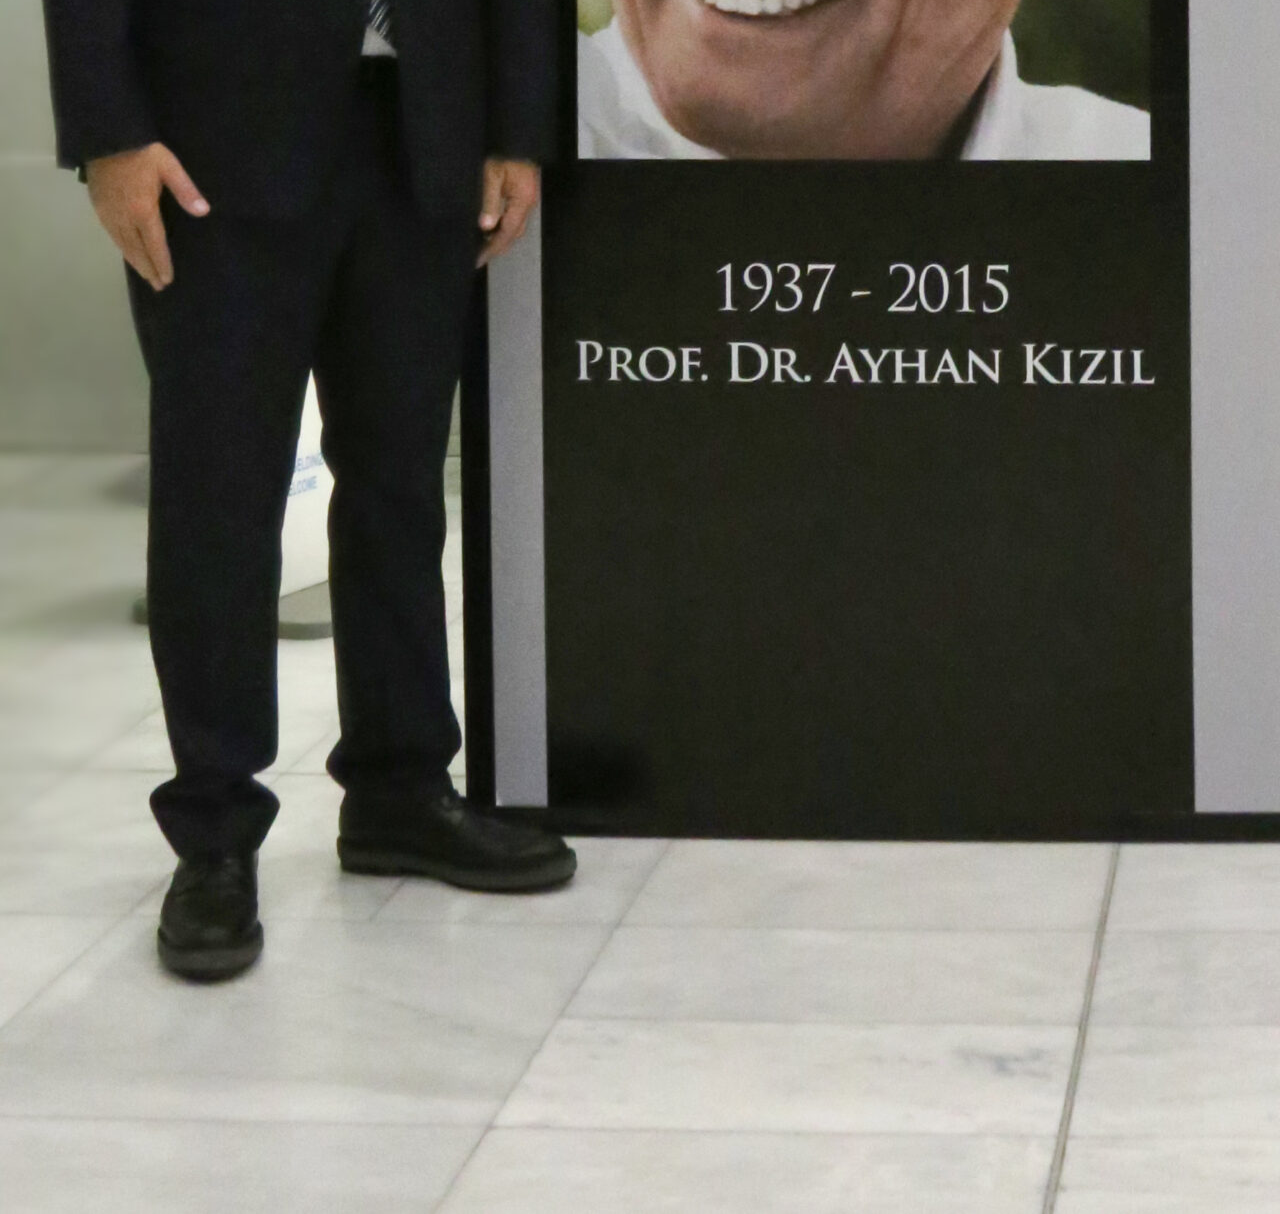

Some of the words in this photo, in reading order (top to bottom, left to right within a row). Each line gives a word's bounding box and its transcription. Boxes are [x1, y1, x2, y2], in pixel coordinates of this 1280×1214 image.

[717, 263, 837, 314] 1937
[888, 264, 1011, 315] 2015
[576, 341, 710, 383] PROF.
[728, 342, 813, 384] DR.
[826, 343, 1003, 385] AYHAN
[1023, 344, 1157, 386] KIZIL
